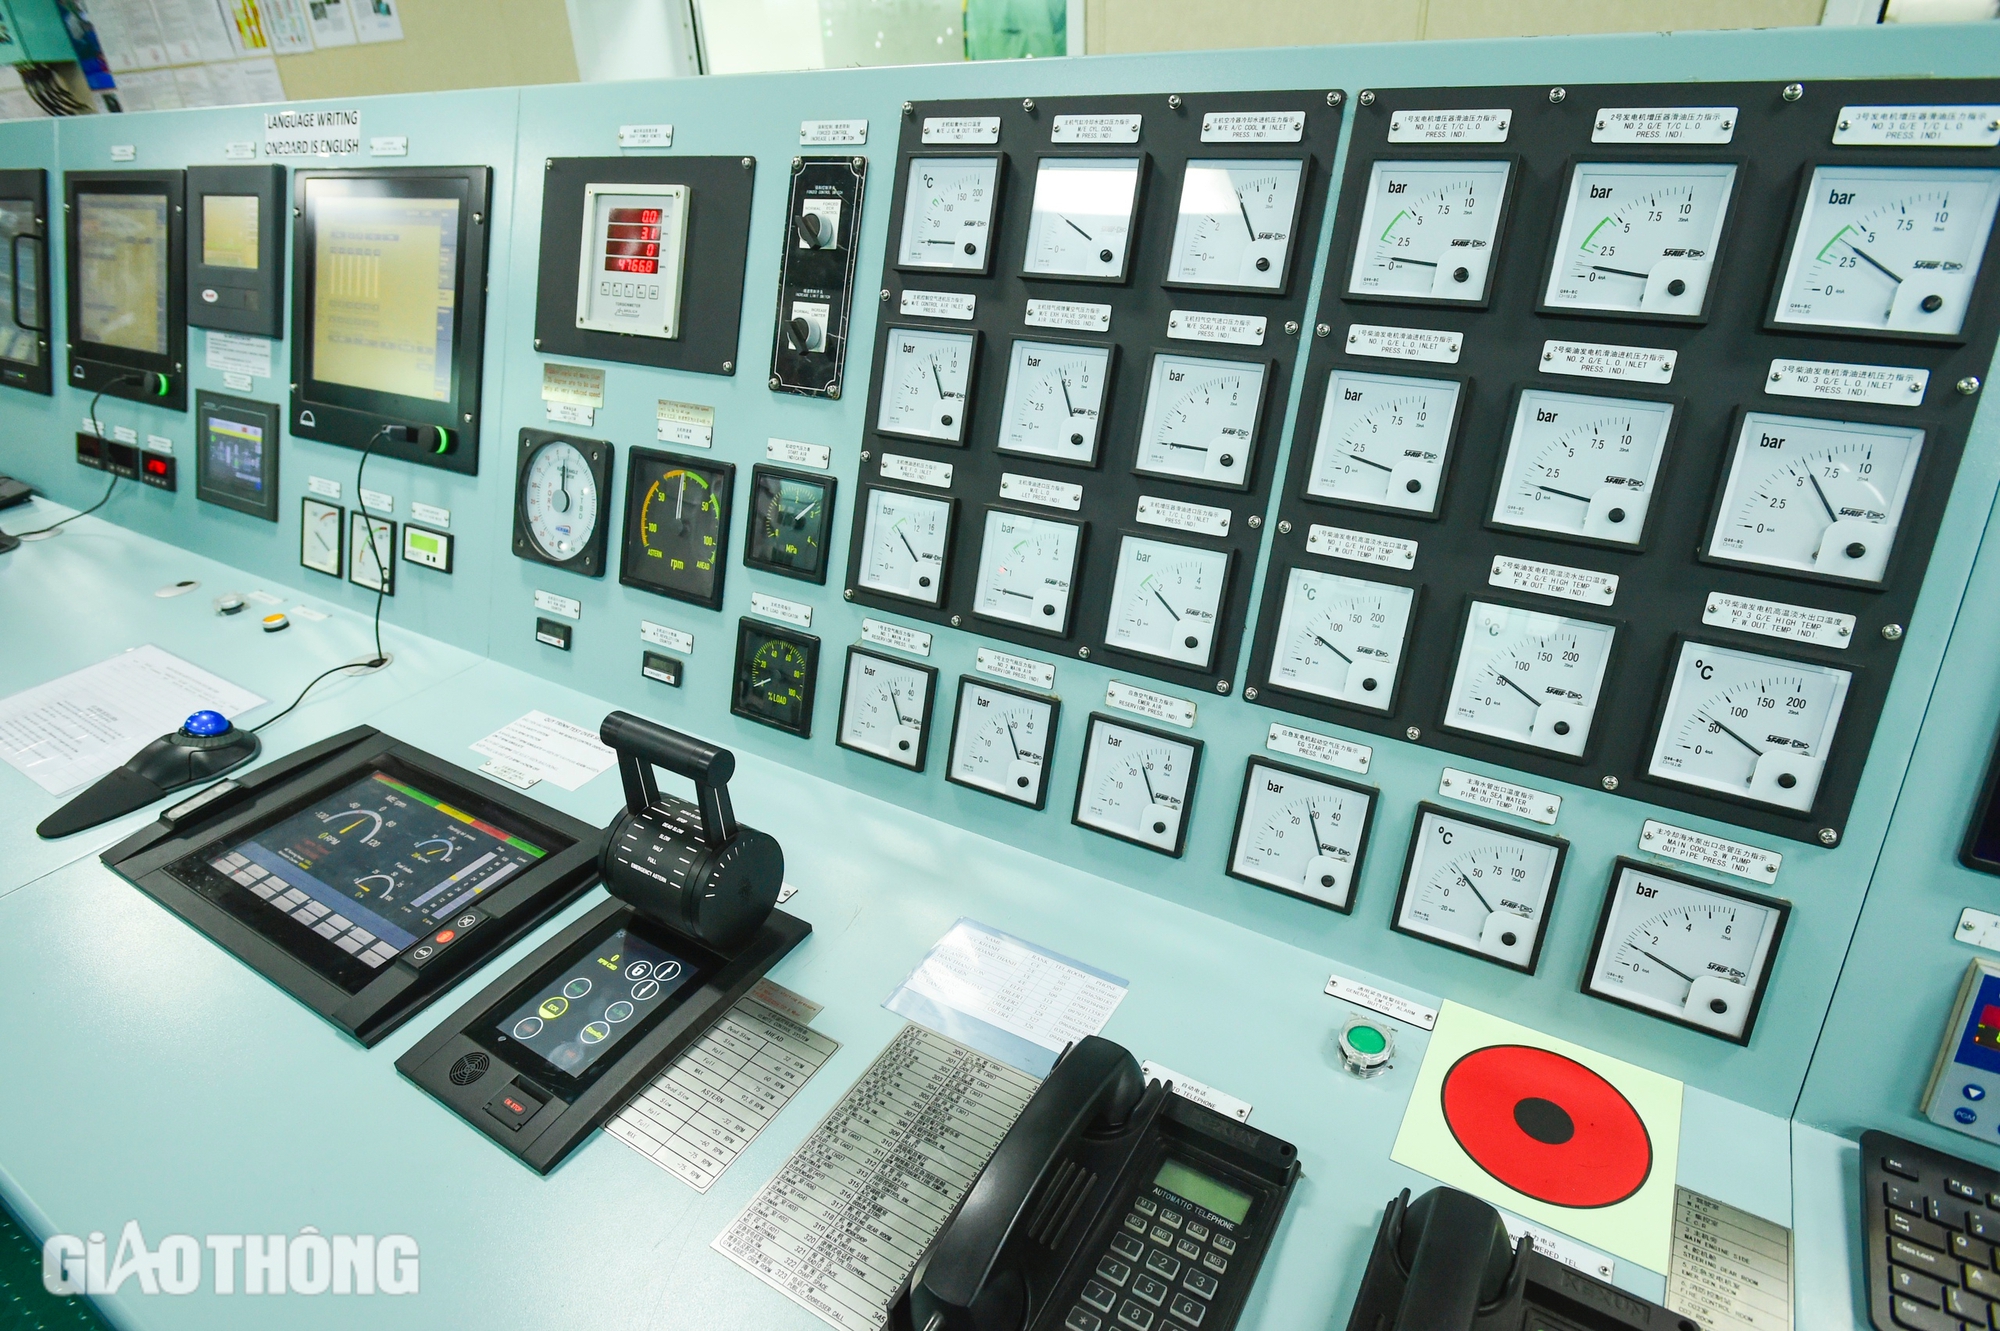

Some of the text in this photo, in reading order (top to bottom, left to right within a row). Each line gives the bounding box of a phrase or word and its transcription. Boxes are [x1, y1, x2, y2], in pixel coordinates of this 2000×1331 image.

[268, 111, 357, 129] LANGUAGE WRITING
[265, 140, 308, 155] ONBOARD
[311, 140, 318, 153] IS
[321, 139, 359, 153] ENGLISH
[1388, 180, 1407, 193] bar
[1589, 184, 1613, 199] bar
[1268, 194, 1273, 203] 6
[1828, 189, 1856, 205] bar
[1896, 220, 1914, 230] 7.5
[1398, 237, 1410, 247] 2.5
[646, 244, 654, 256] 0
[1600, 246, 1615, 257] 2.5
[1202, 252, 1207, 261] 0
[1839, 257, 1857, 268] 2.5
[1027, 355, 1041, 367] bar
[1081, 374, 1089, 383] 10
[1169, 370, 1185, 382] bar
[1048, 386, 1053, 394] 5
[1344, 388, 1363, 402] bar
[1034, 402, 1044, 411] 2.5
[1182, 414, 1187, 423] 2
[1536, 408, 1558, 423] bar
[1760, 432, 1786, 450] bar
[1353, 443, 1366, 453] 2.5
[1546, 468, 1560, 478] 2.5
[658, 492, 665, 502] 50
[1770, 497, 1787, 509] 2.5
[701, 501, 709, 512] 50
[882, 505, 895, 516] bar
[913, 525, 920, 533] 12
[928, 523, 935, 531] 16
[786, 543, 798, 554] MPa
[670, 558, 684, 570] rpm
[696, 561, 710, 570] AHEAD
[1348, 613, 1363, 624] 150
[1370, 612, 1385, 623] 200
[1756, 613, 1771, 623] G/E
[1775, 617, 1797, 628] HIGH
[1329, 622, 1343, 633] 100
[1562, 651, 1580, 662] 200
[760, 660, 767, 668] 20
[1514, 660, 1530, 672] 100
[793, 670, 800, 678] 80
[788, 688, 796, 697] 100
[1756, 697, 1775, 709] 150
[1730, 706, 1748, 718] 100
[1107, 734, 1122, 747] bar
[1308, 743, 1325, 752] START
[1328, 748, 1339, 756] AIR
[1128, 768, 1138, 777] 20
[1266, 780, 1284, 794] bar
[1470, 786, 1527, 806] MAIN SEA WATER
[1291, 816, 1301, 825] 20
[659, 833, 672, 842] SLOW
[1472, 868, 1483, 878] 50
[1510, 867, 1526, 879] 100
[1635, 882, 1659, 899] bar
[1632, 963, 1640, 972] 0
[763, 1030, 784, 1042] AHEAD
[700, 1088, 725, 1104] ASTERN
[1956, 1110, 1976, 1122] PGM
[1889, 1159, 1902, 1168] Esc
[1152, 1186, 1235, 1232] AUTOMATIC TELEPHONE
[812, 1221, 826, 1232] 319
[803, 1232, 816, 1244] 320
[1956, 1236, 1968, 1247] Q
[1684, 1233, 1701, 1244] MAIN
[1704, 1241, 1730, 1256] ENGINE
[1897, 1242, 1936, 1263] Caps Lock
[783, 1256, 797, 1269] 322
[1158, 1256, 1167, 1268] 2
[1682, 1251, 1717, 1270] STEERING
[774, 1269, 788, 1281] 323
[1108, 1263, 1117, 1275] 4
[1195, 1276, 1206, 1287] 3
[1972, 1269, 1983, 1282] A
[1145, 1282, 1154, 1293] 5
[1131, 1308, 1140, 1320] 8
[1183, 1302, 1193, 1314] 6
